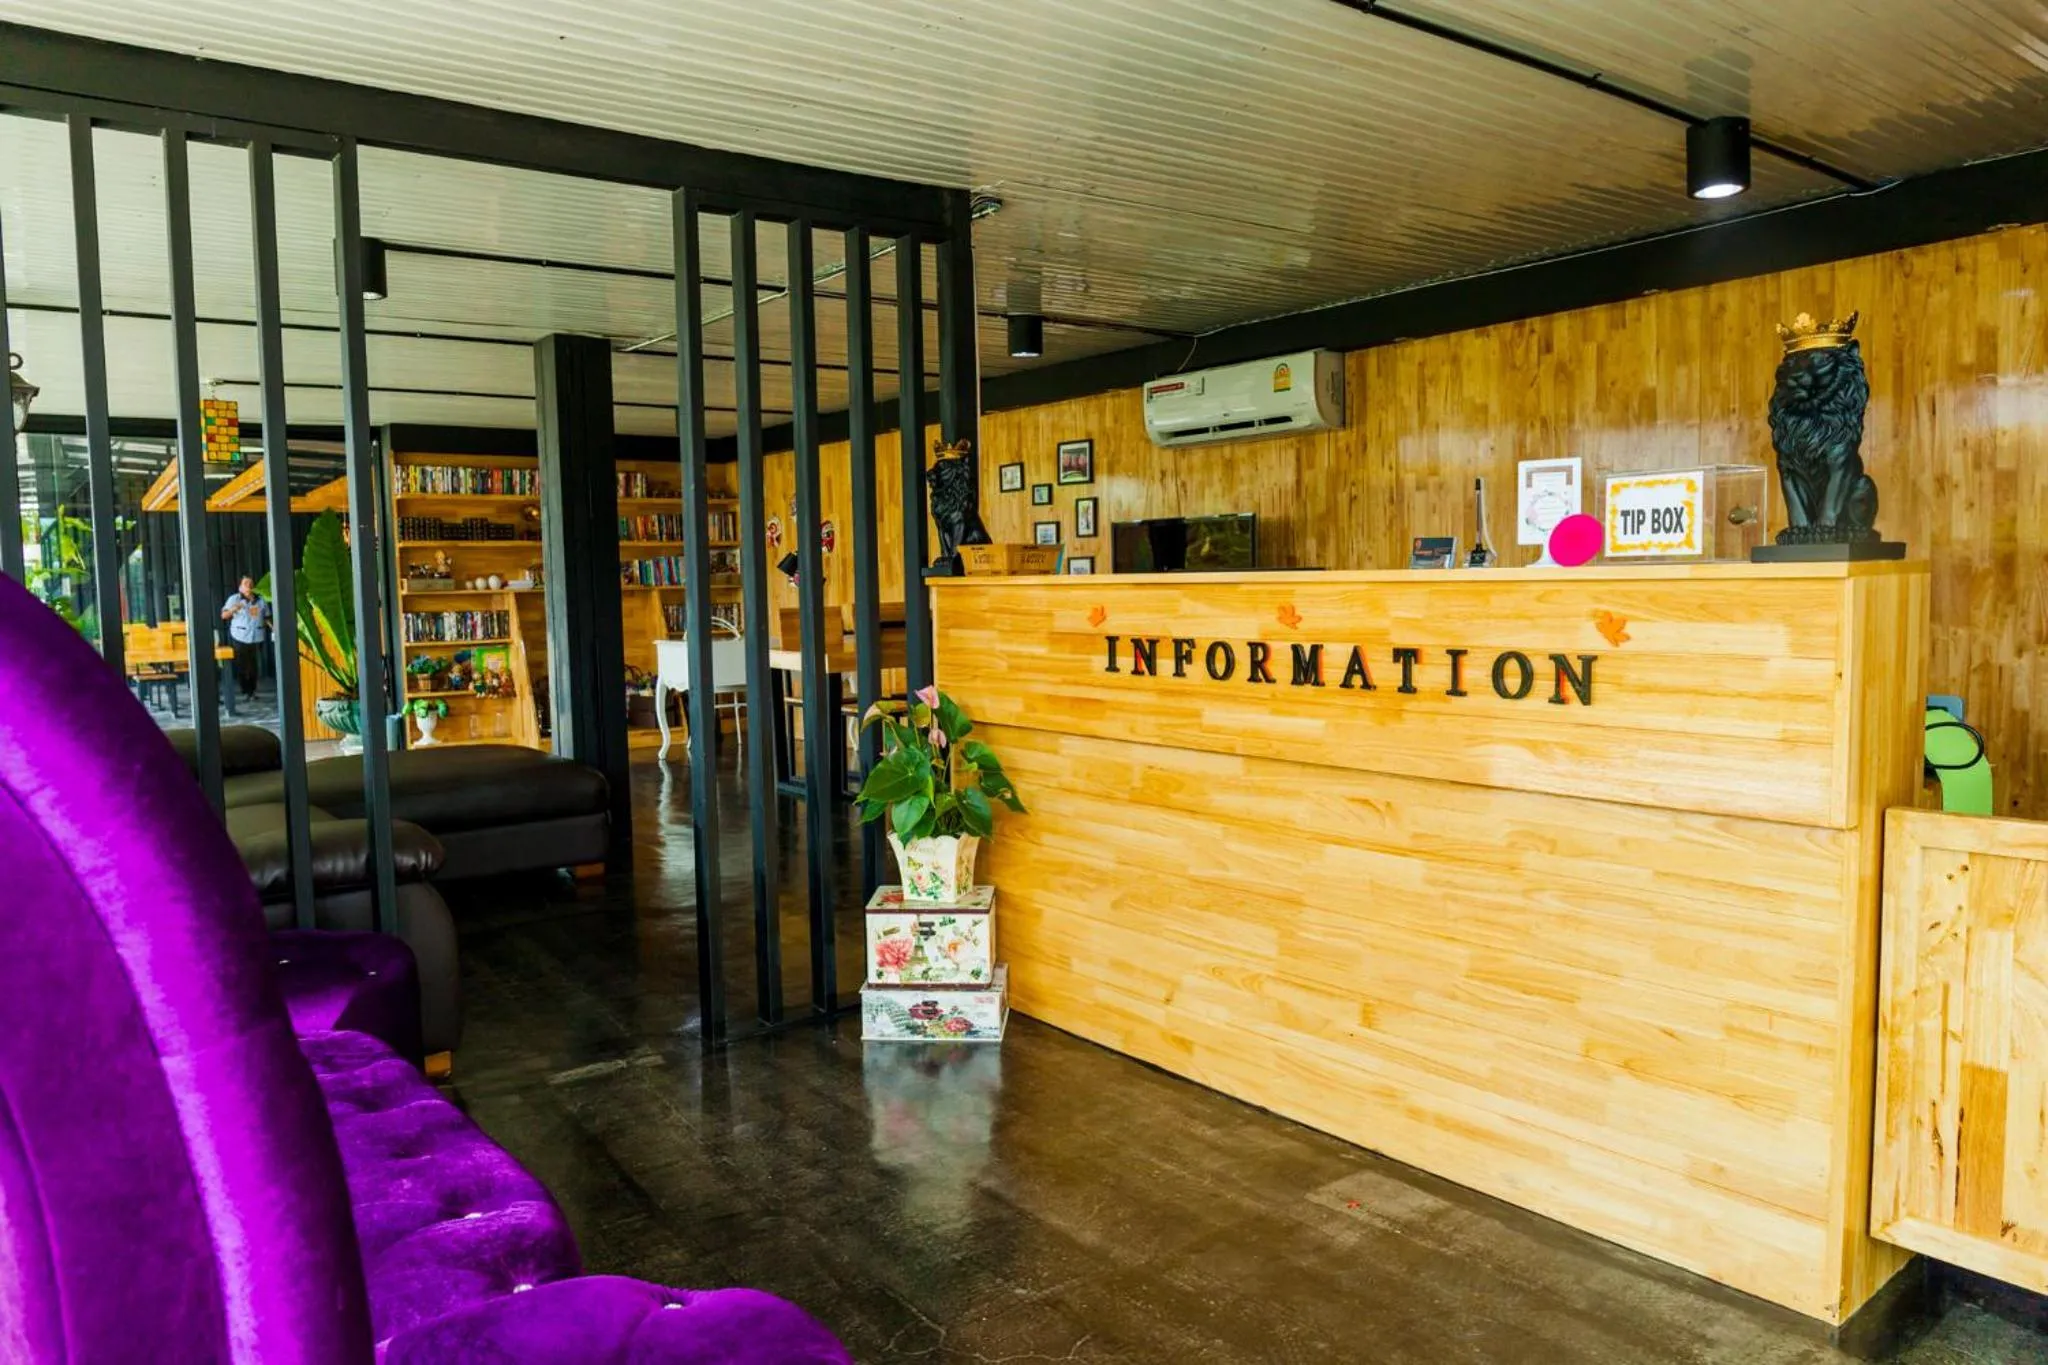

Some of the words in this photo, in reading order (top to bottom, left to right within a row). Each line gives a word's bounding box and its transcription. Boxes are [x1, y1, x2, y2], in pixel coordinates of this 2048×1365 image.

[1620, 509, 1646, 536] TIP
[1651, 506, 1685, 535] BOX
[1104, 635, 1599, 706] INFORMATION
